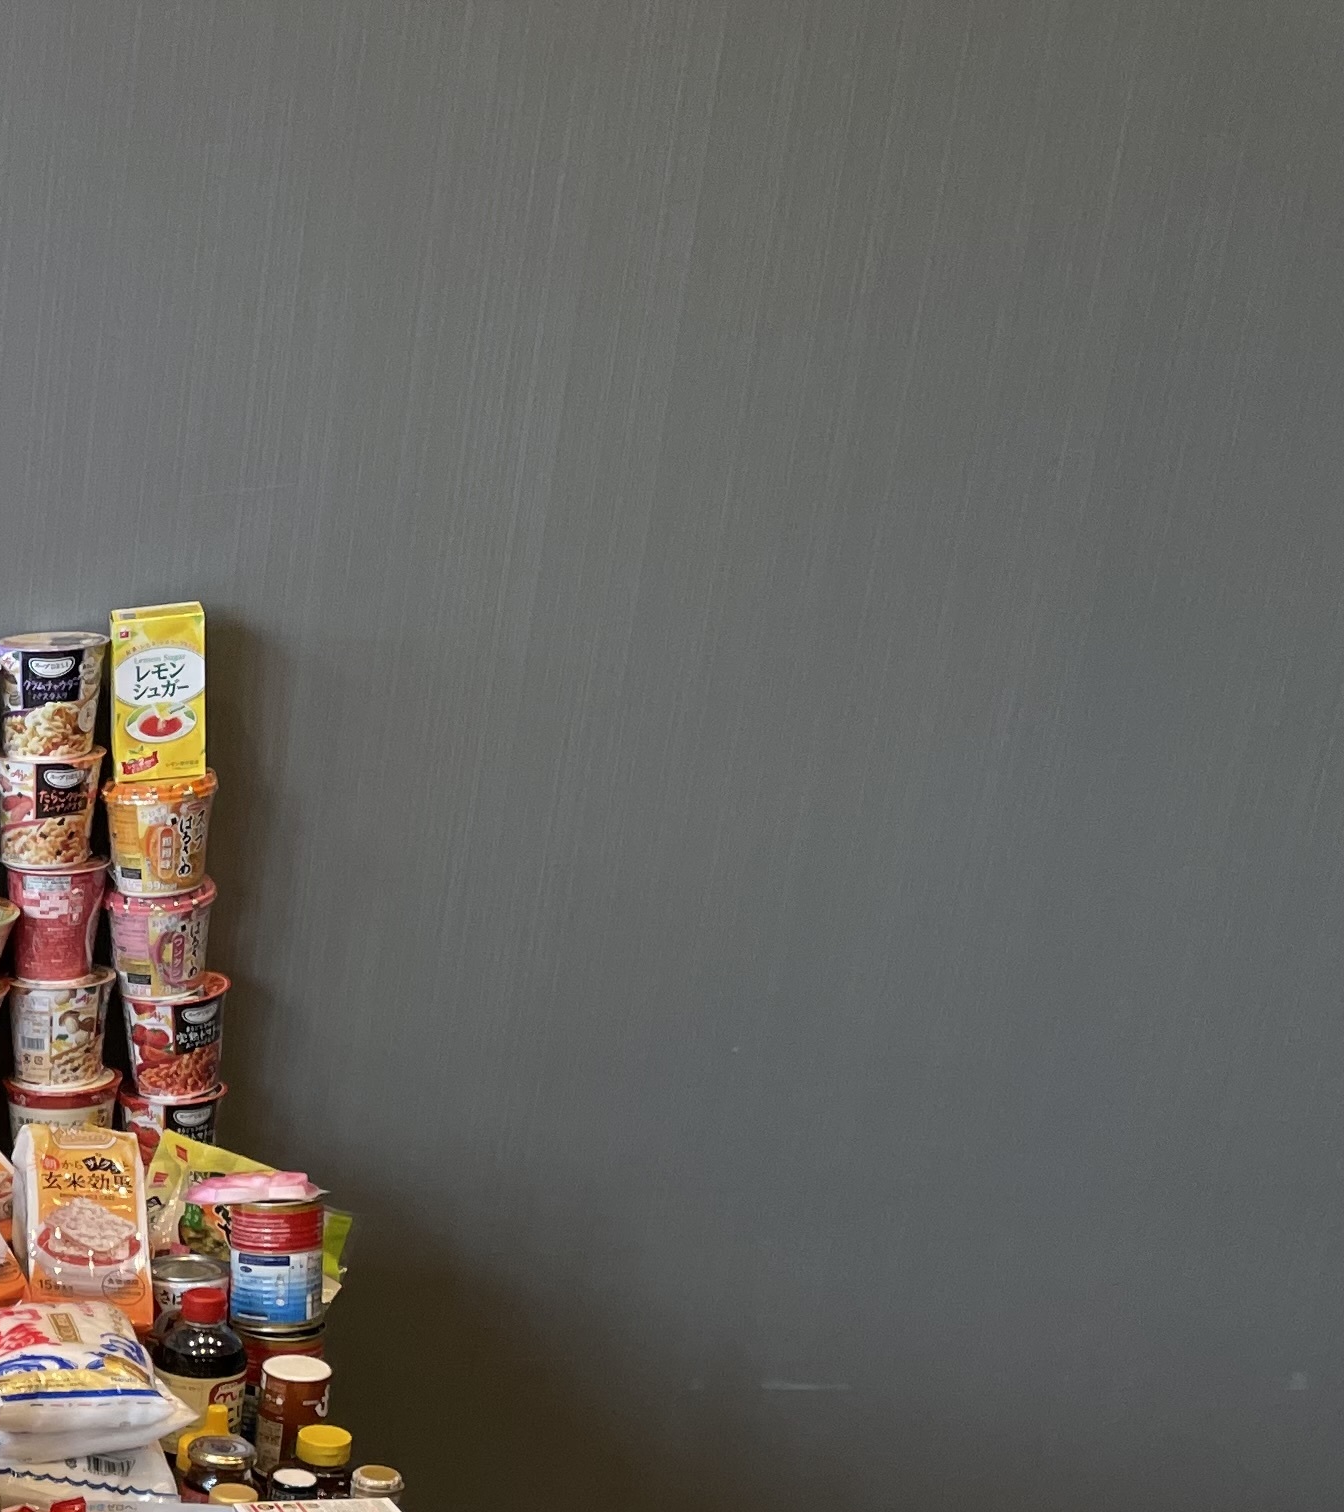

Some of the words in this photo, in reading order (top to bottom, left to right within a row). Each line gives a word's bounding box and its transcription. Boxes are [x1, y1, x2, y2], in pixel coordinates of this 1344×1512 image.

[134, 662, 185, 680] レモン
[133, 679, 190, 699] シュガー
[41, 1172, 132, 1192] 玄米効果
